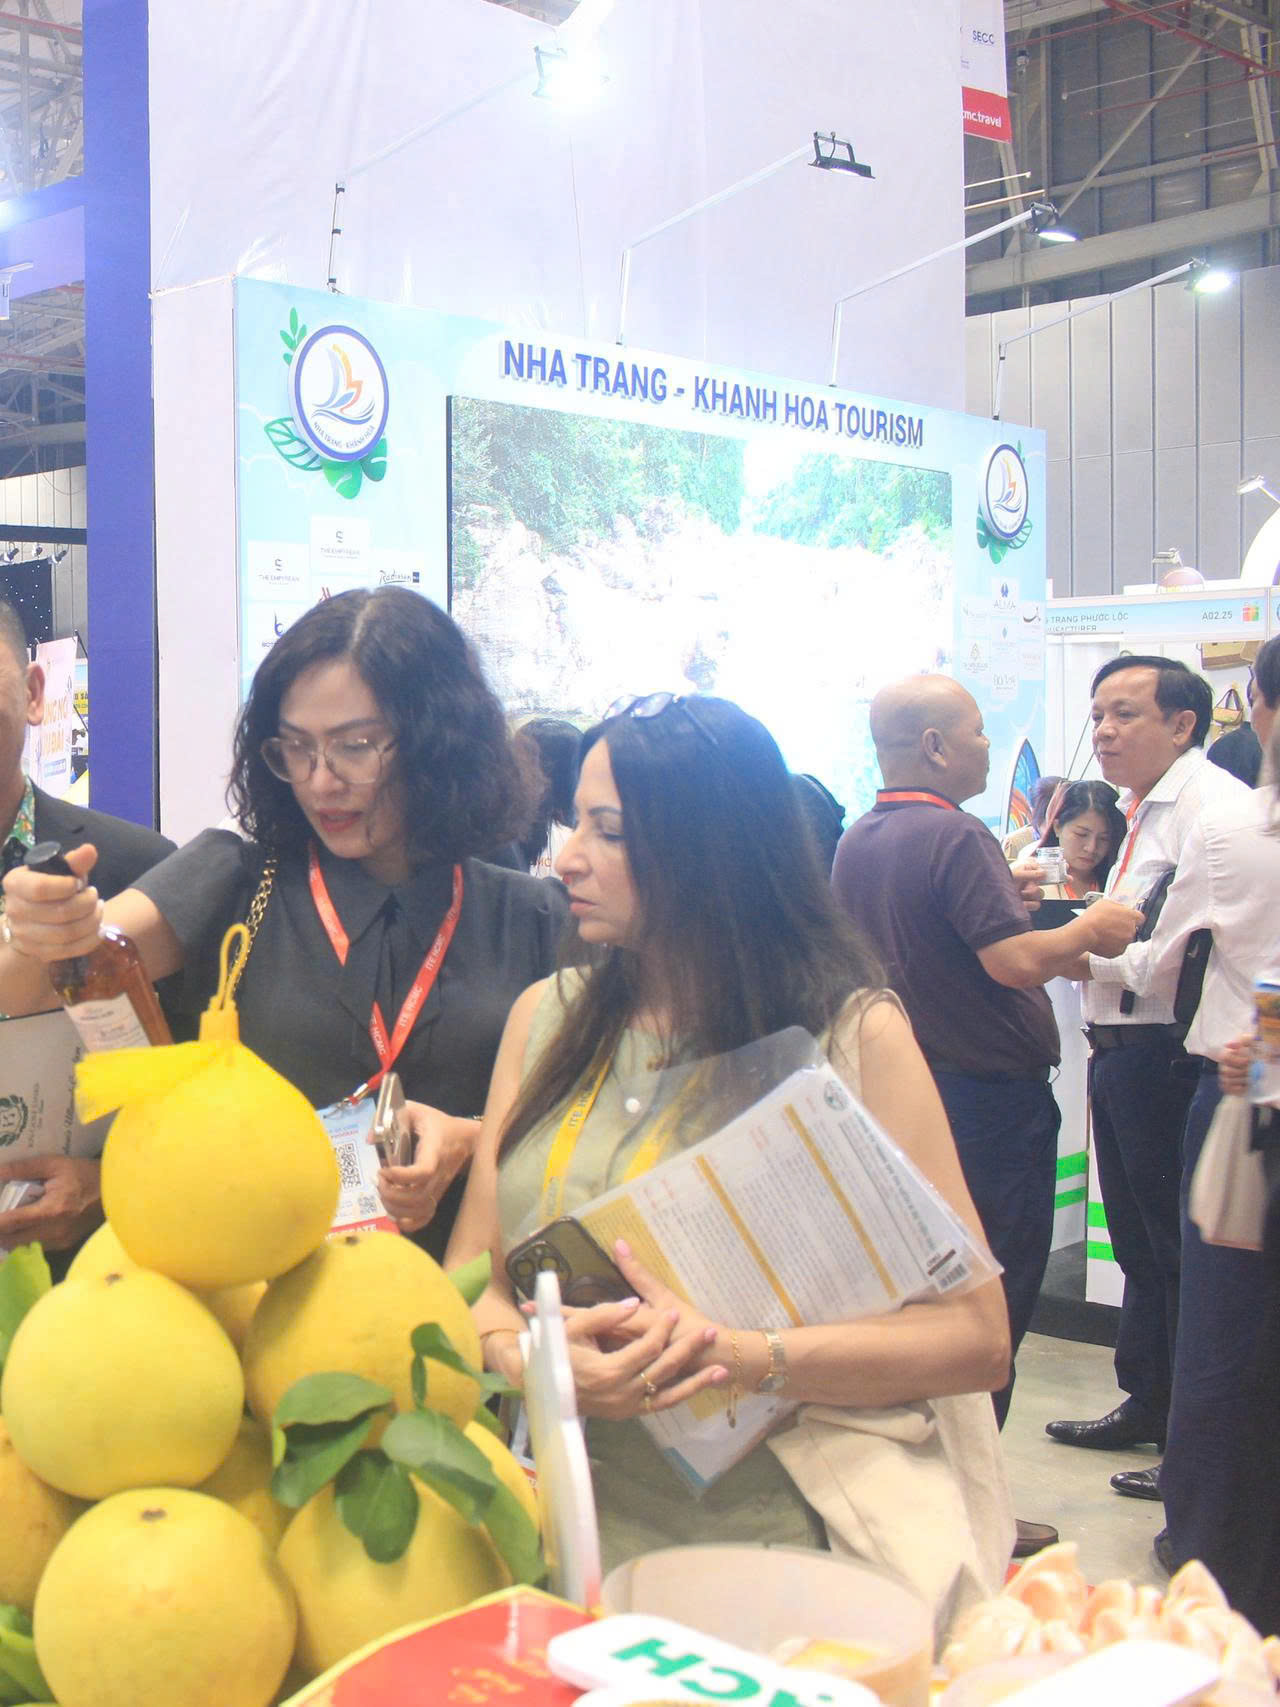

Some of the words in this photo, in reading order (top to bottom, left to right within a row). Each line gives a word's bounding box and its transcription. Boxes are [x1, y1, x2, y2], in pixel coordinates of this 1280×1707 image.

[503, 340, 567, 386] NHA
[575, 353, 668, 402] TRANG
[693, 376, 778, 422] KHANH
[783, 394, 829, 431] HOA
[834, 402, 924, 448] TOURISM
